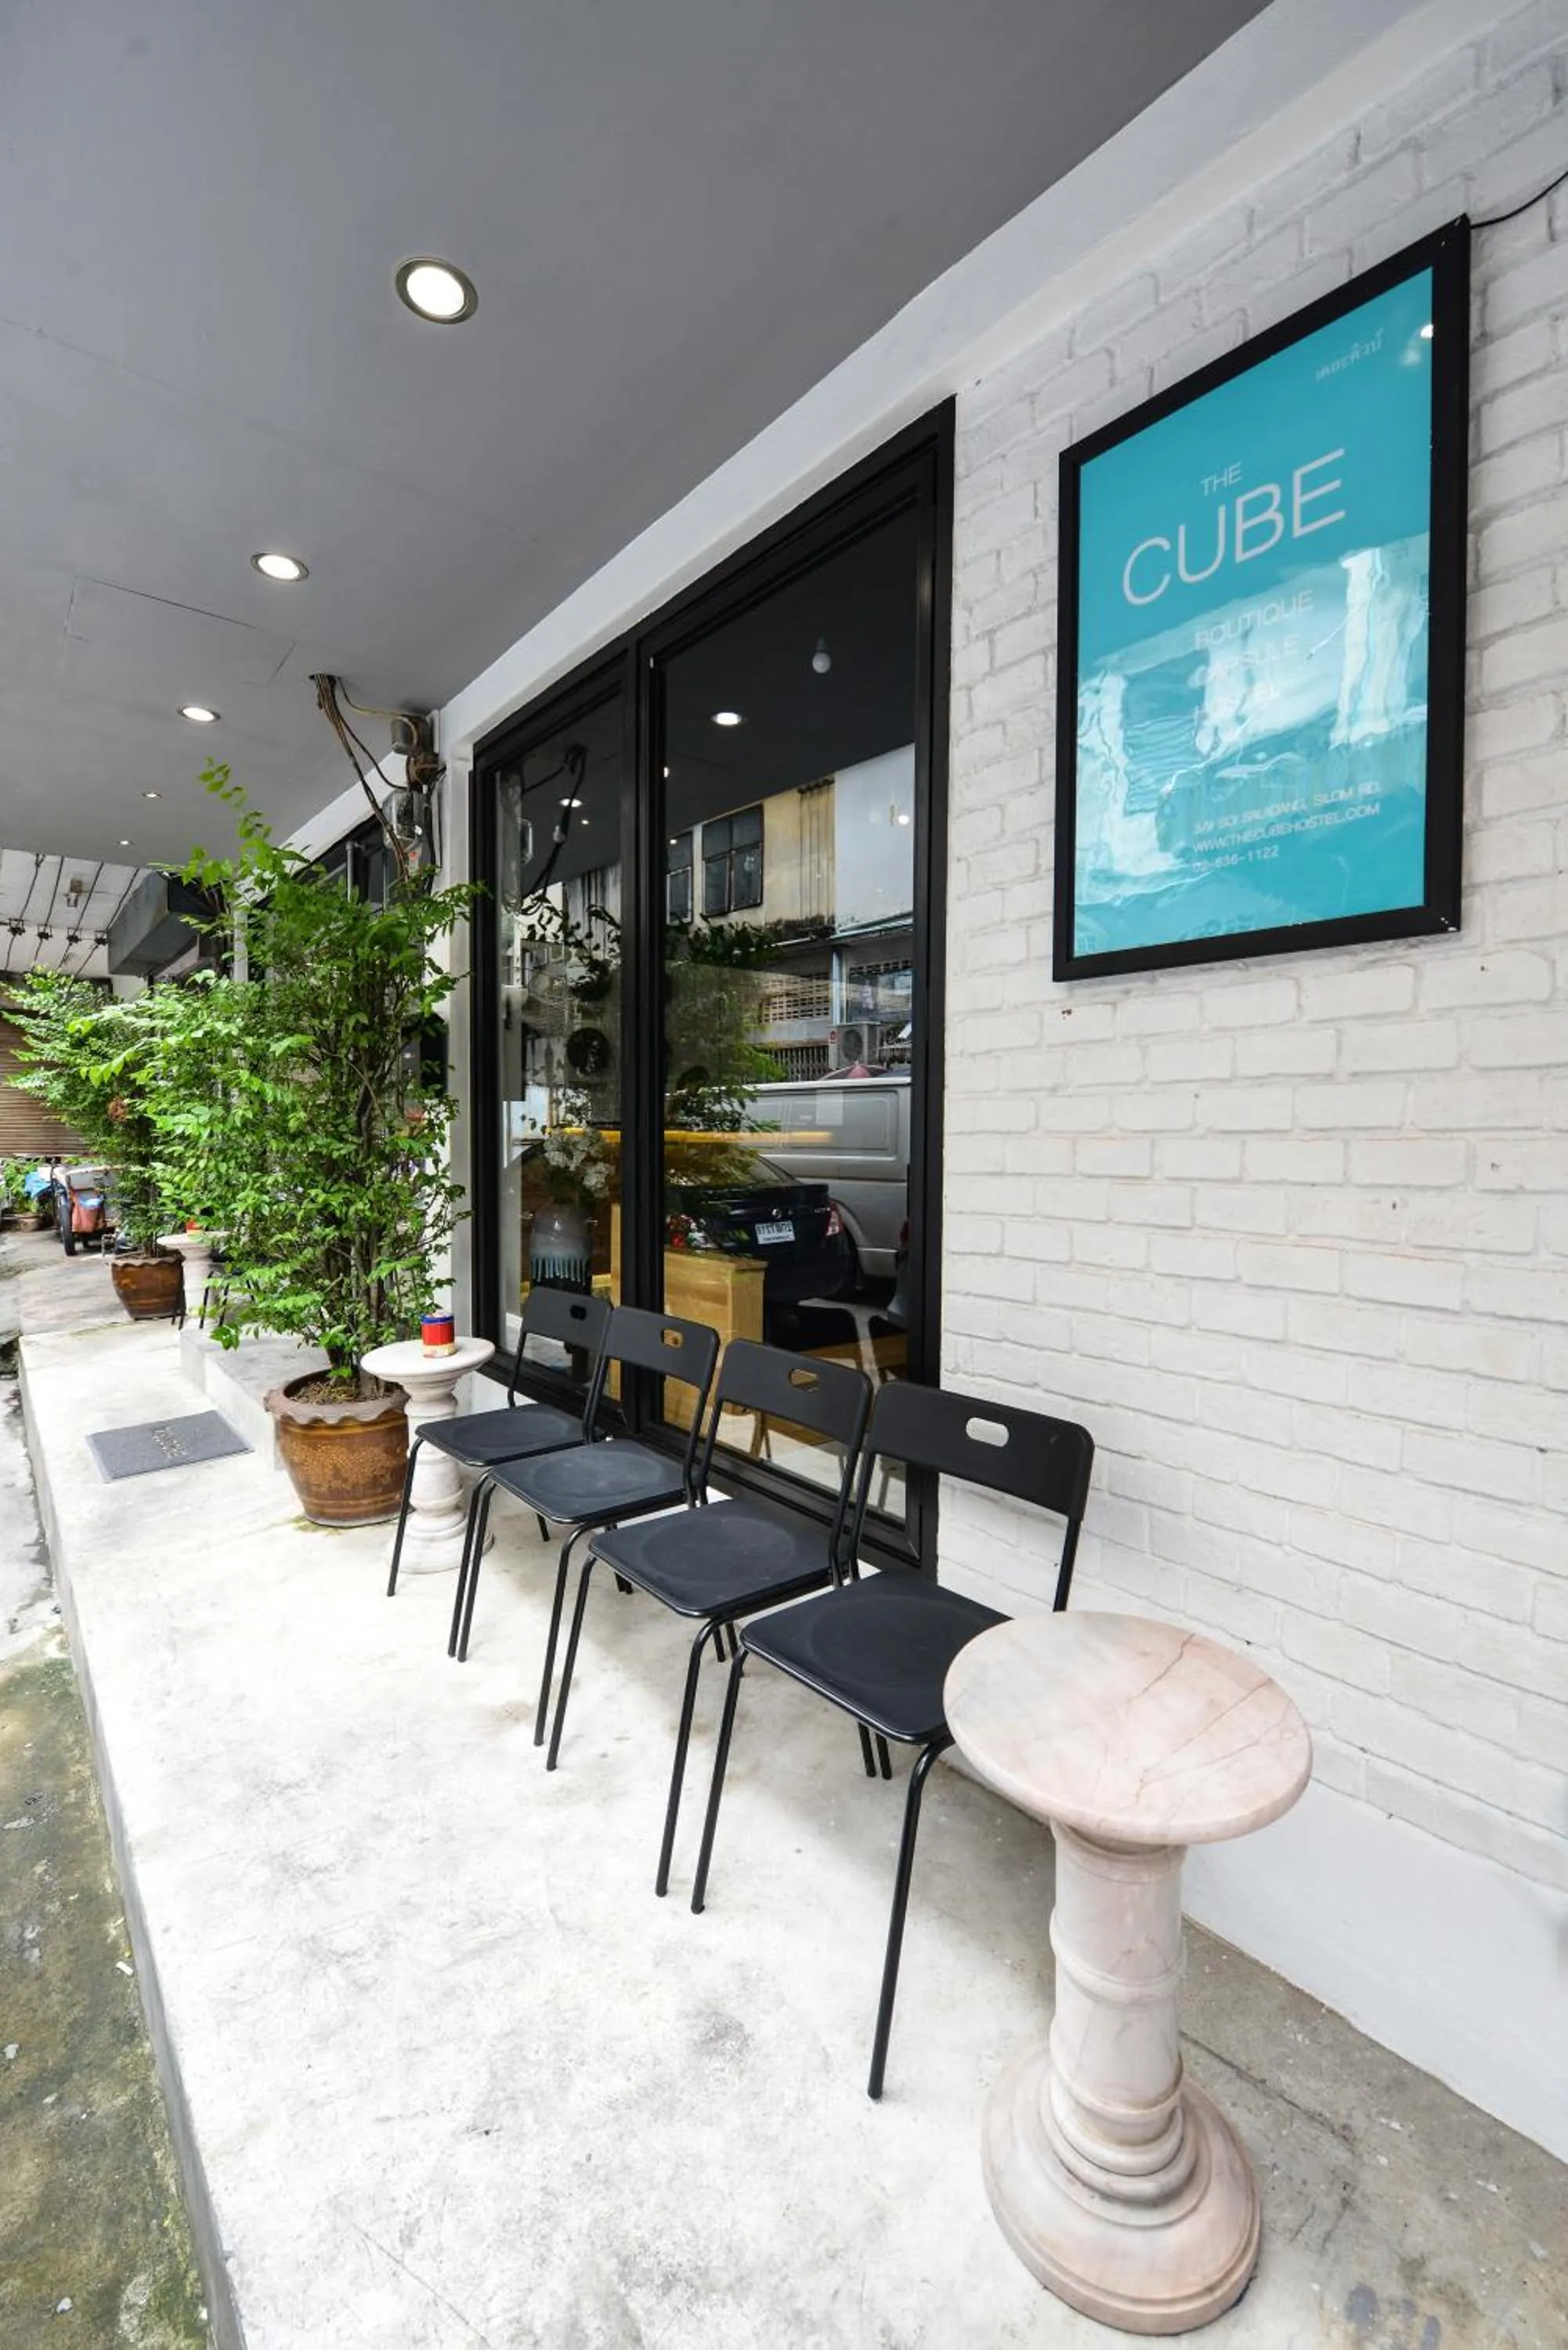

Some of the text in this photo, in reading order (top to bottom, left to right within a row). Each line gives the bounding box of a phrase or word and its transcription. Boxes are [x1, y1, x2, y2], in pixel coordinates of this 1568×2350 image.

[1200, 461, 1243, 497] THE
[1122, 447, 1346, 606] CUBE
[1194, 588, 1315, 649] BOUTIQUE
[1194, 634, 1299, 685] CAPSULE
[1313, 787, 1354, 807] SILOM
[1192, 801, 1381, 853] WWW.THECUBEHOSTEL.COM
